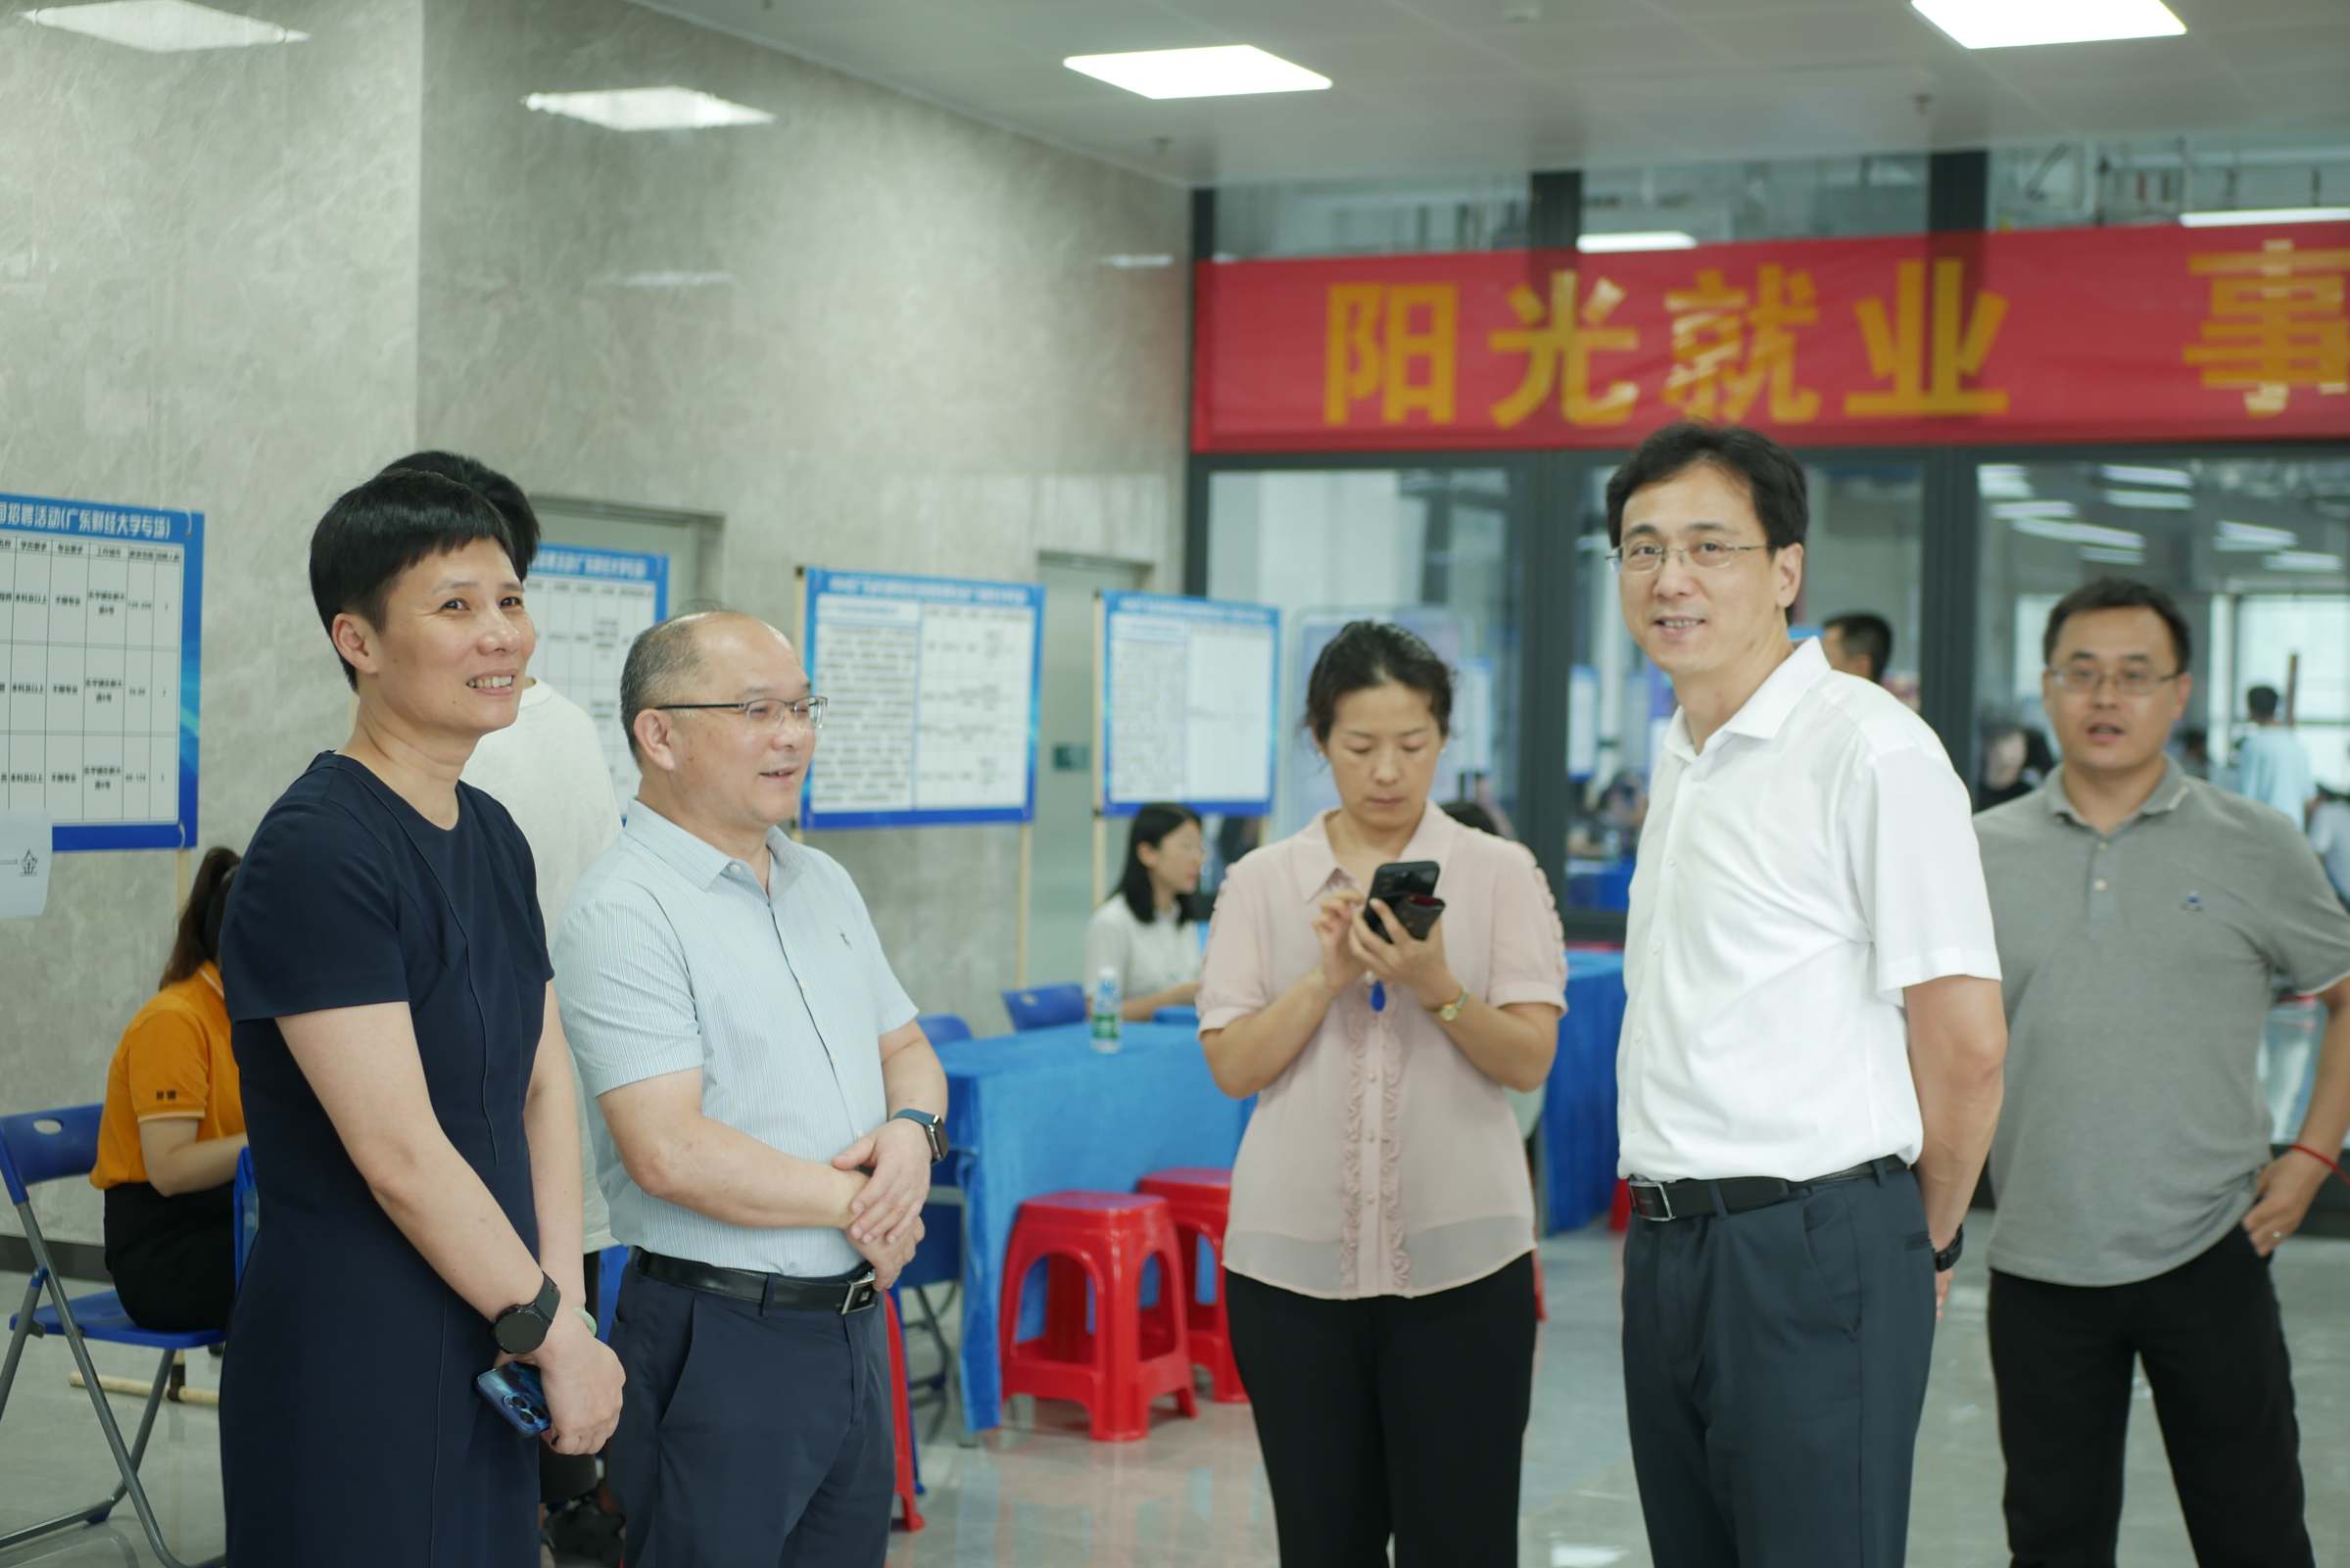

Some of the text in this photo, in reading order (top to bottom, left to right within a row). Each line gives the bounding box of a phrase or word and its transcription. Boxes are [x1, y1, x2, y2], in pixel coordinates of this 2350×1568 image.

[1324, 239, 2350, 429] 阳光就业 事
